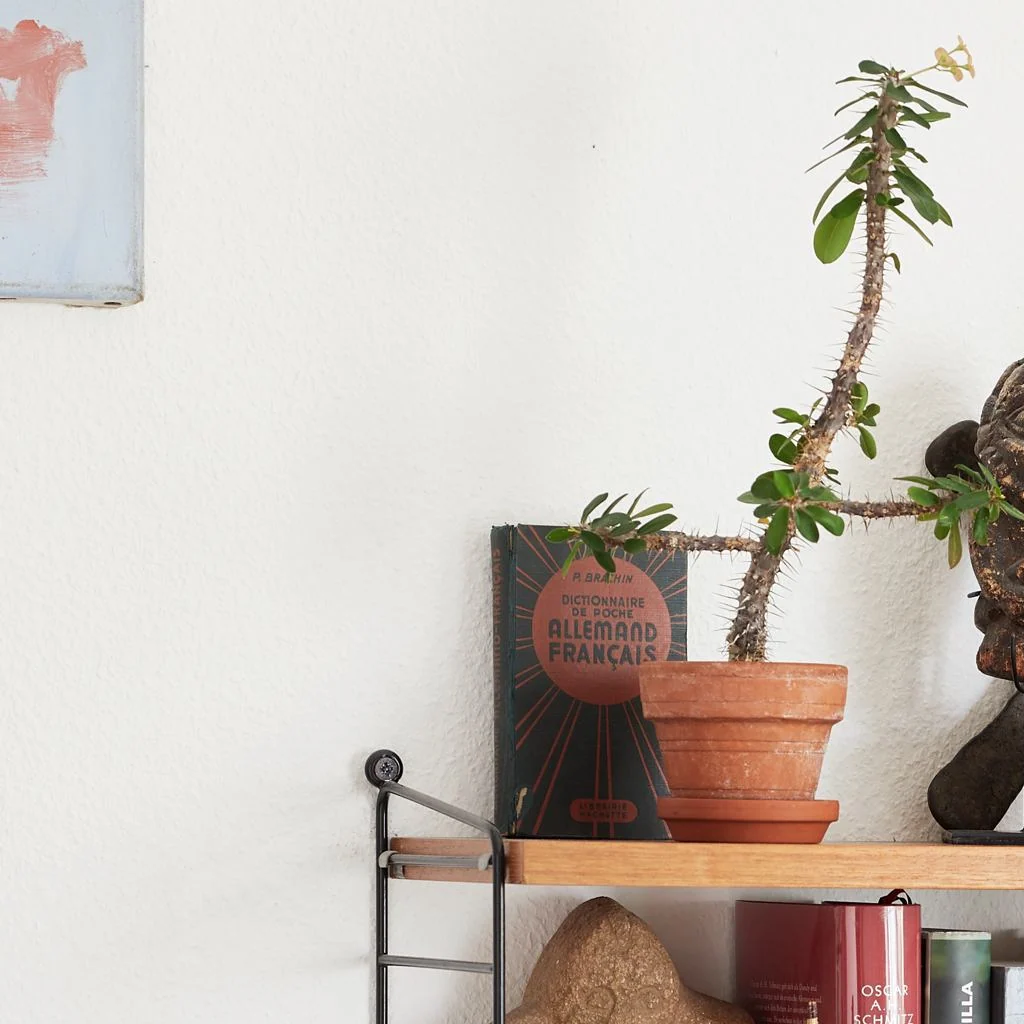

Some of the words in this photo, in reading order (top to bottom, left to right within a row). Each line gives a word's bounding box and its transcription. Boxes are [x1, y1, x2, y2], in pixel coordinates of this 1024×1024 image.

[562, 595, 646, 608] DICTIONNAIRE
[572, 608, 589, 618] DE
[594, 608, 634, 619] POCHE
[548, 618, 658, 643] ALLEMAND
[548, 643, 657, 671] FRANÇAIS
[861, 984, 909, 998] OSCAR
